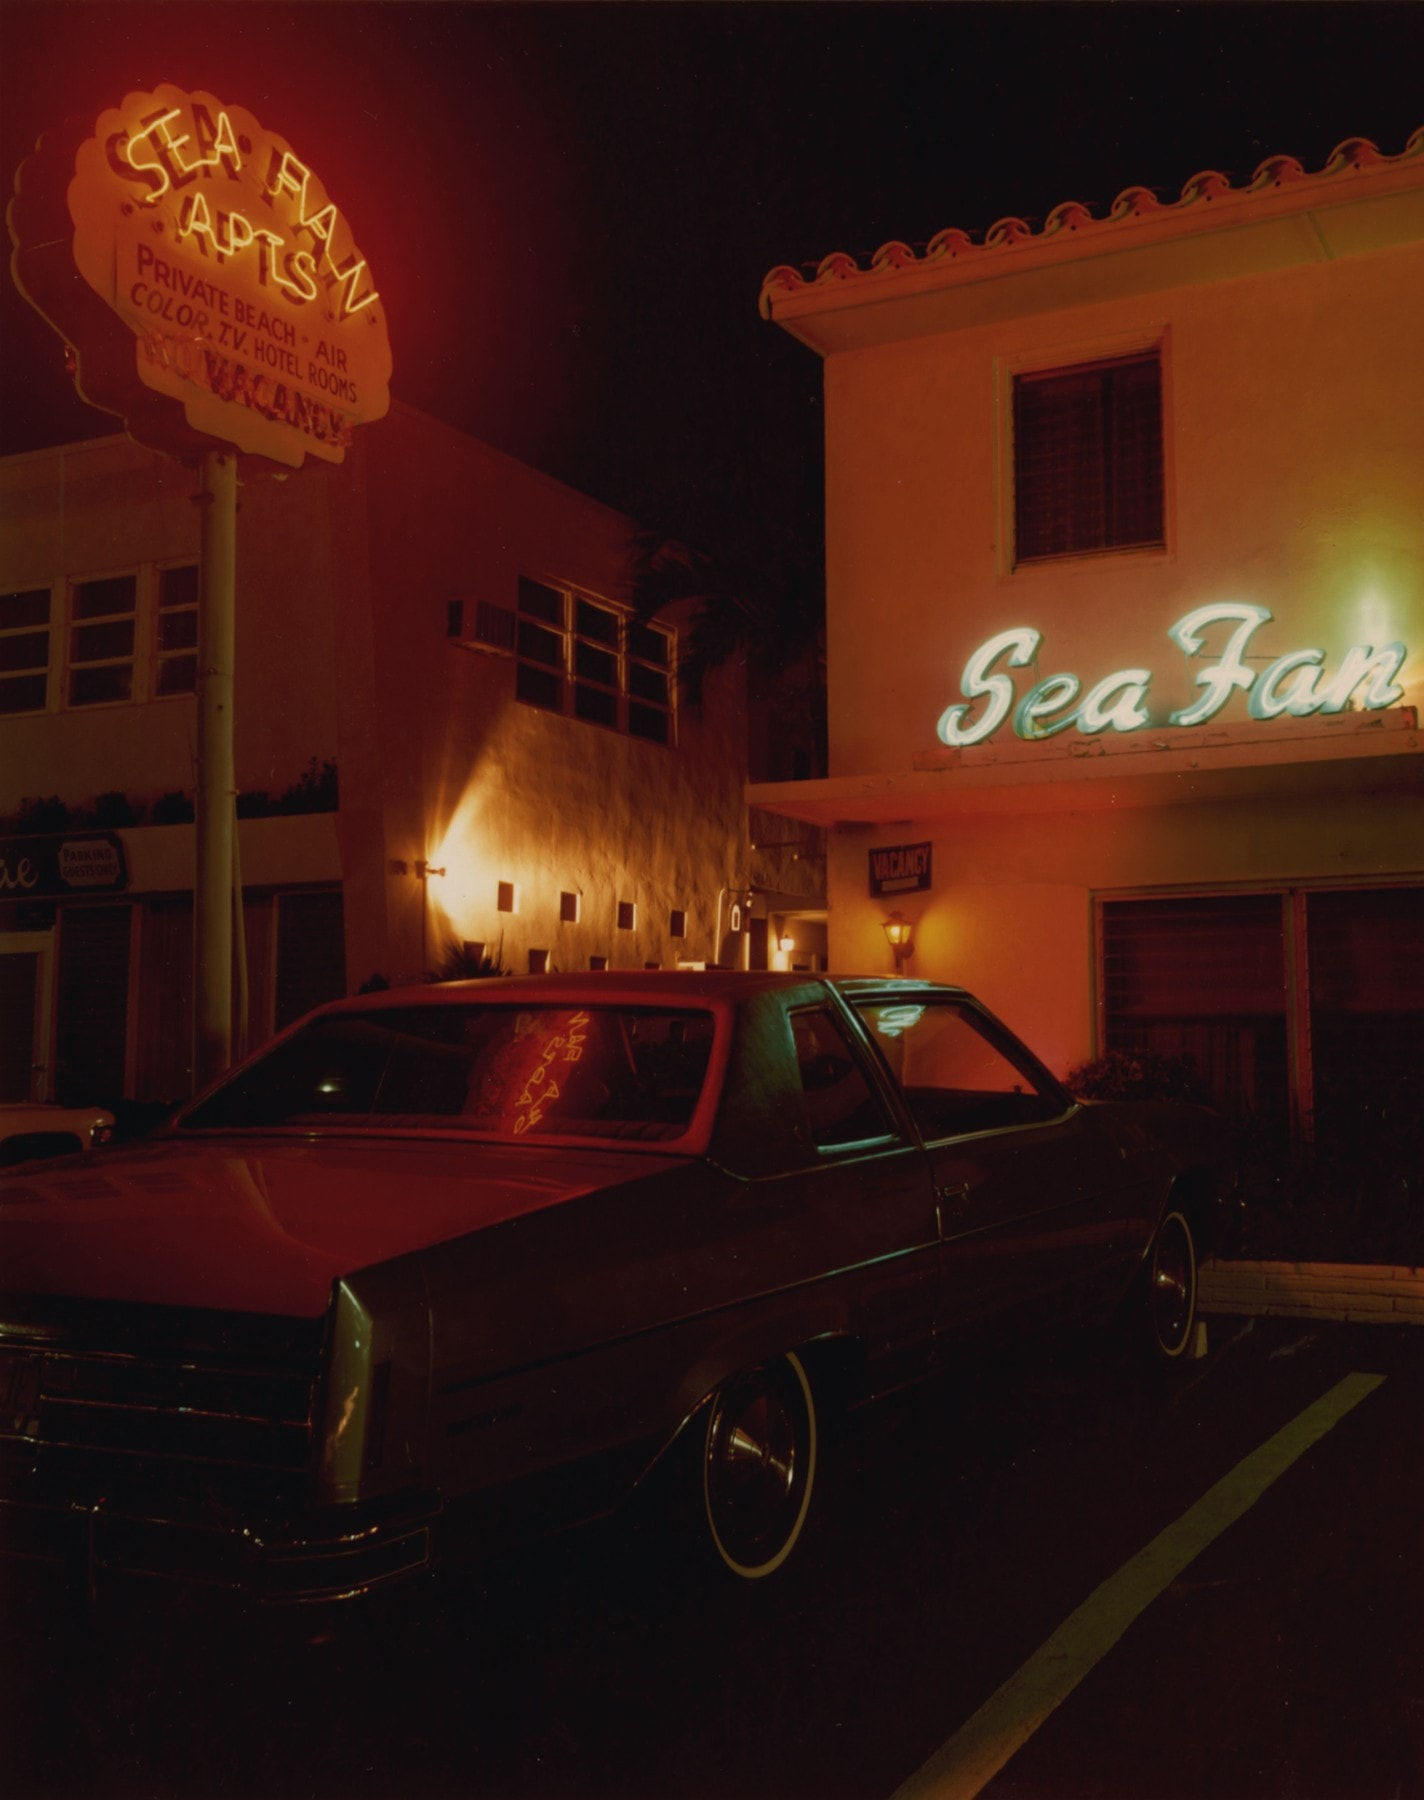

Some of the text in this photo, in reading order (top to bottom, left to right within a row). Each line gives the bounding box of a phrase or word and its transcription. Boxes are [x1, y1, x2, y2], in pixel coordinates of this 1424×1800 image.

[105, 103, 380, 322] SEA FAN
[174, 192, 318, 305] APTS
[136, 243, 348, 374] PRIVATE BEACH AIR
[203, 349, 346, 446] VACANCY
[254, 338, 303, 381] HOTEL
[308, 362, 358, 403] ROOMS
[936, 602, 1408, 747] Sea Fan
[63, 848, 112, 862] PARKING
